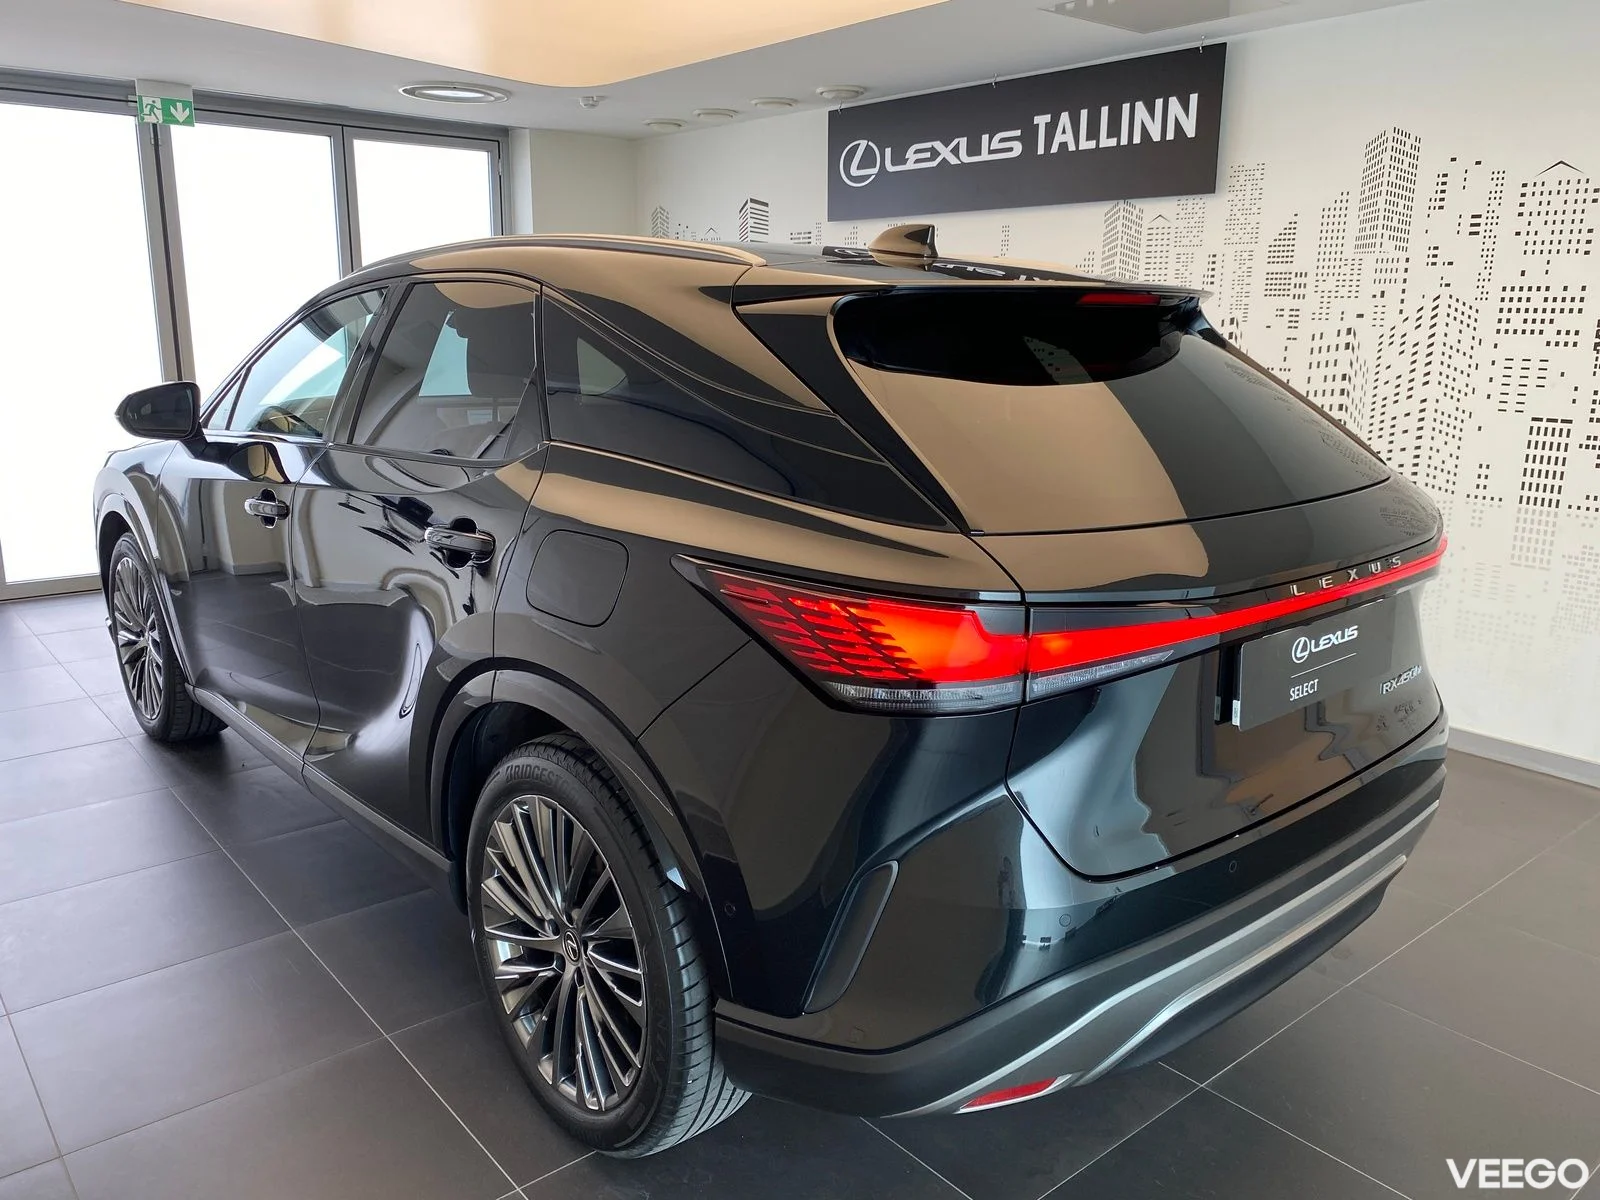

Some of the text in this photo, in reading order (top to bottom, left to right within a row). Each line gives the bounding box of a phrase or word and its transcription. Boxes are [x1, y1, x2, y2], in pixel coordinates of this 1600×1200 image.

[884, 129, 1022, 172] LEXUS
[1033, 92, 1199, 156] TALLINN
[1290, 555, 1402, 596] LEXUS
[1310, 625, 1359, 653] LEXUS
[1289, 678, 1320, 702] SELECT
